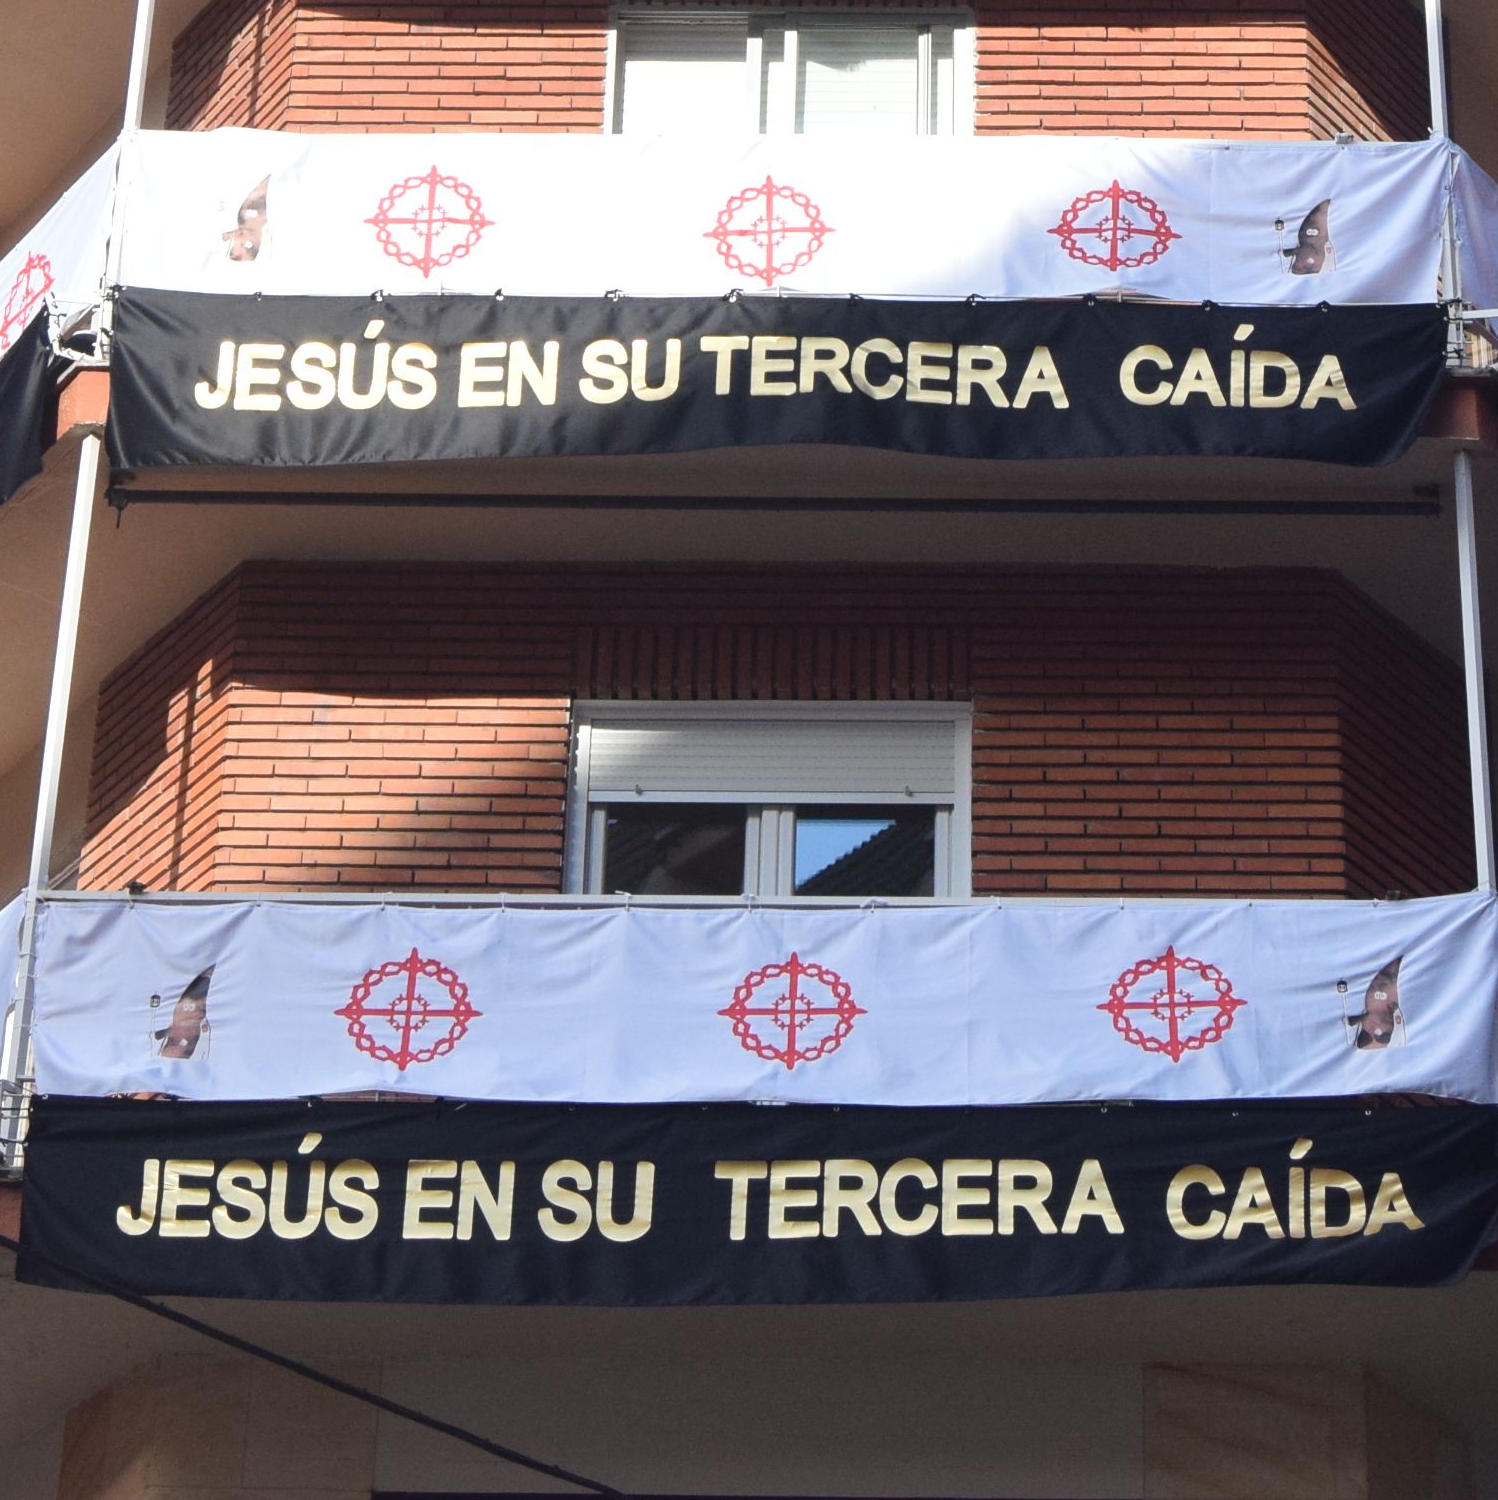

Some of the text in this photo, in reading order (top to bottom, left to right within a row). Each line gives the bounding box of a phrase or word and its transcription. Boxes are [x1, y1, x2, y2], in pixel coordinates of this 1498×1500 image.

[194, 317, 1356, 414] JESÚS EN SU TERCERA CAÍDA
[117, 1133, 1424, 1241] JESÚS EN SU TERCERA CAÍDA
